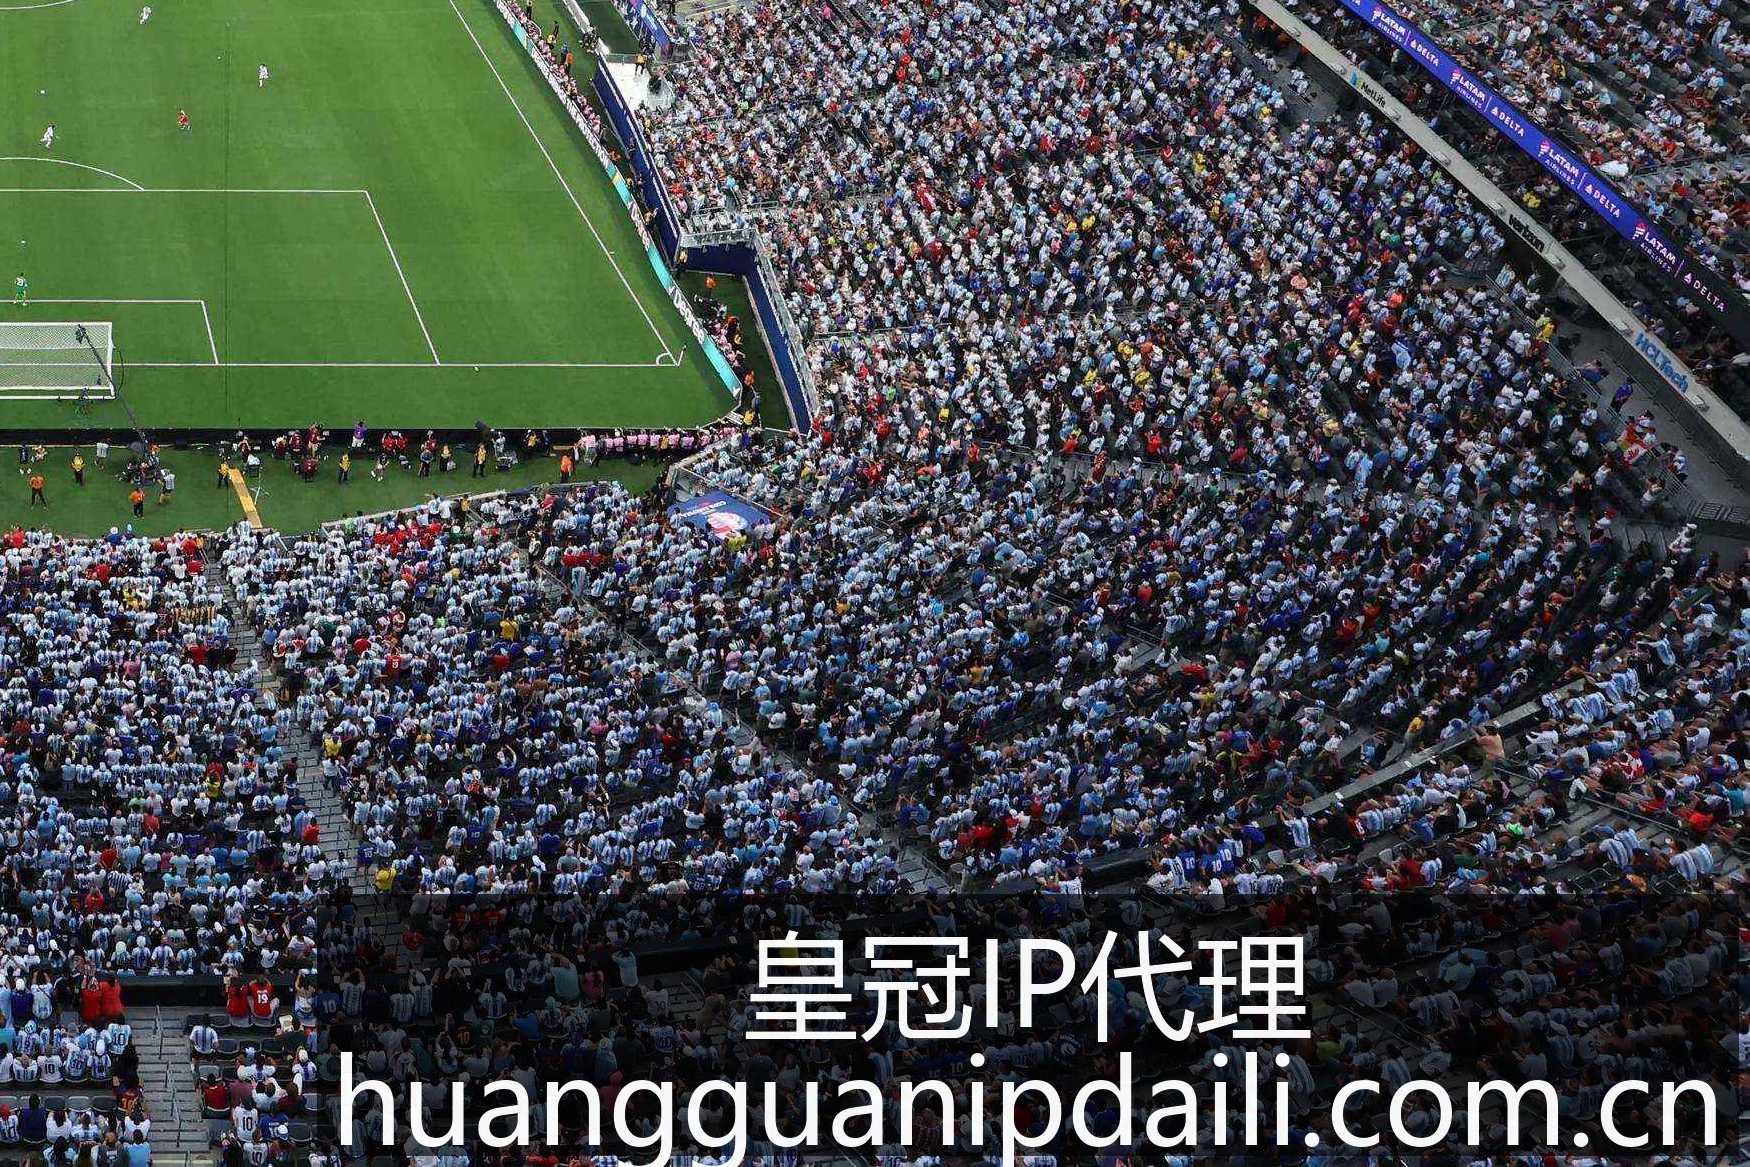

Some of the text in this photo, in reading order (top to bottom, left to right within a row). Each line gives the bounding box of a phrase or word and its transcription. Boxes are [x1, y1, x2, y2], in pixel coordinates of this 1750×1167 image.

[1381, 13, 1405, 35] LATAM
[1417, 43, 1439, 66] DELTA
[1360, 82, 1387, 109] MetLife
[1459, 75, 1485, 101] LATAM
[1498, 112, 1525, 137] DELTA
[1549, 149, 1580, 177] LATAM
[1593, 190, 1621, 218] DELTA
[1509, 214, 1545, 252] verizon
[1645, 232, 1676, 265] LATAM
[1693, 281, 1728, 312] DELTA
[673, 291, 705, 345] Degree
[1221, 849, 1232, 861] 10
[1185, 857, 1195, 868] 10
[1212, 861, 1222, 872] 10
[257, 993, 268, 1004] 19
[322, 999, 336, 1013] 10
[112, 1033, 124, 1045] 10
[45, 1062, 55, 1074] 10
[243, 1117, 253, 1131] 10
[252, 1152, 262, 1163] 10
